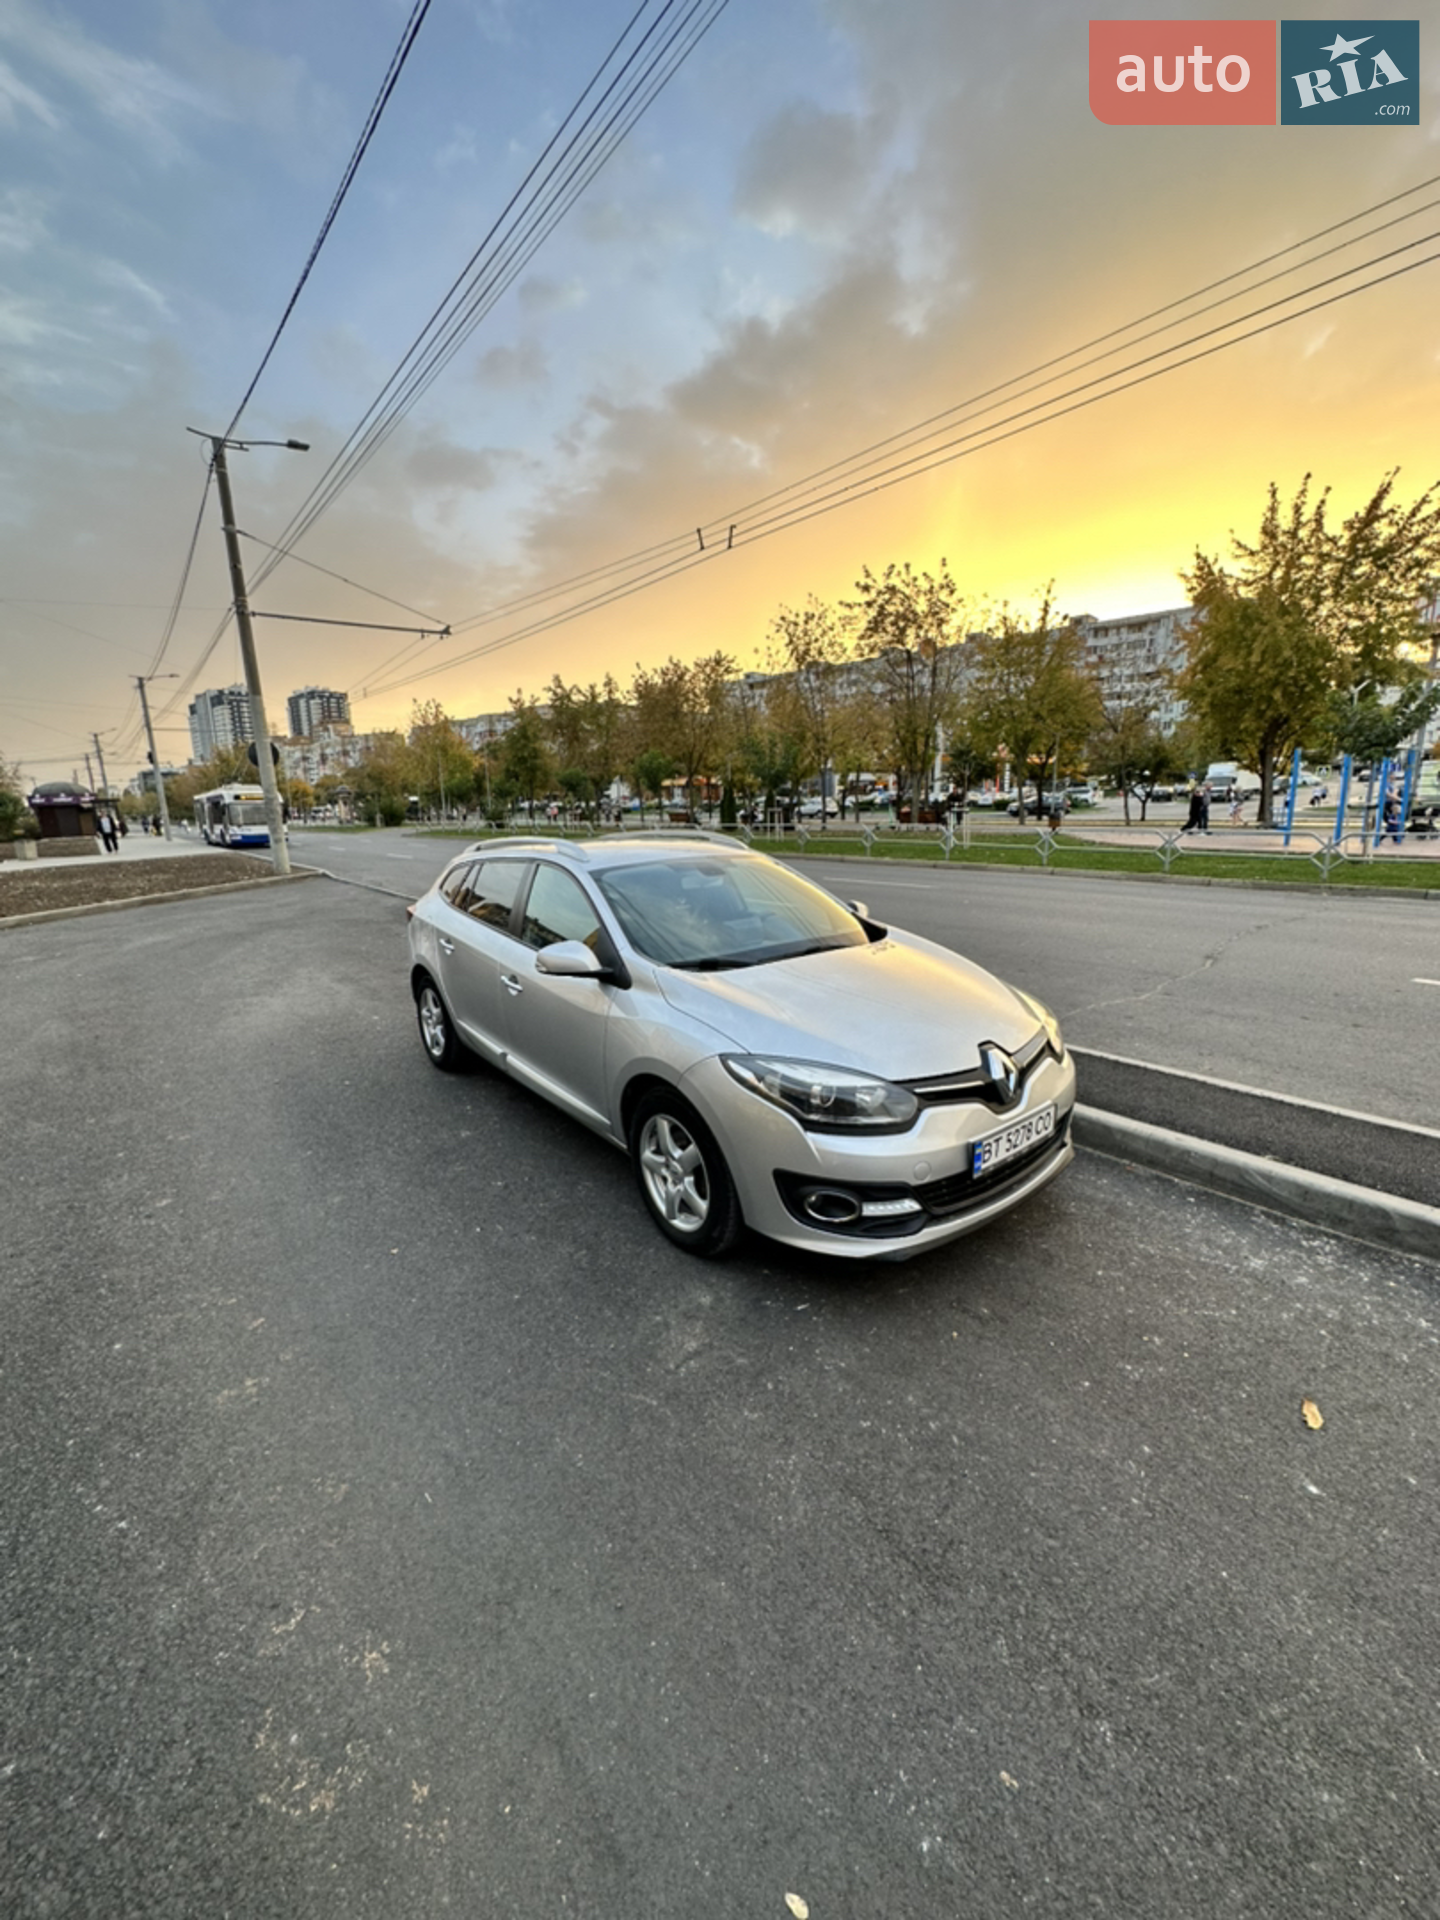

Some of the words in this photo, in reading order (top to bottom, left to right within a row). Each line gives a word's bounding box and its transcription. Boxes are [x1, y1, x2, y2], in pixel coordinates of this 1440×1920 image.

[983, 1136, 1003, 1163] BT
[1006, 1121, 1033, 1153] 5278
[1035, 1112, 1052, 1135] CO
